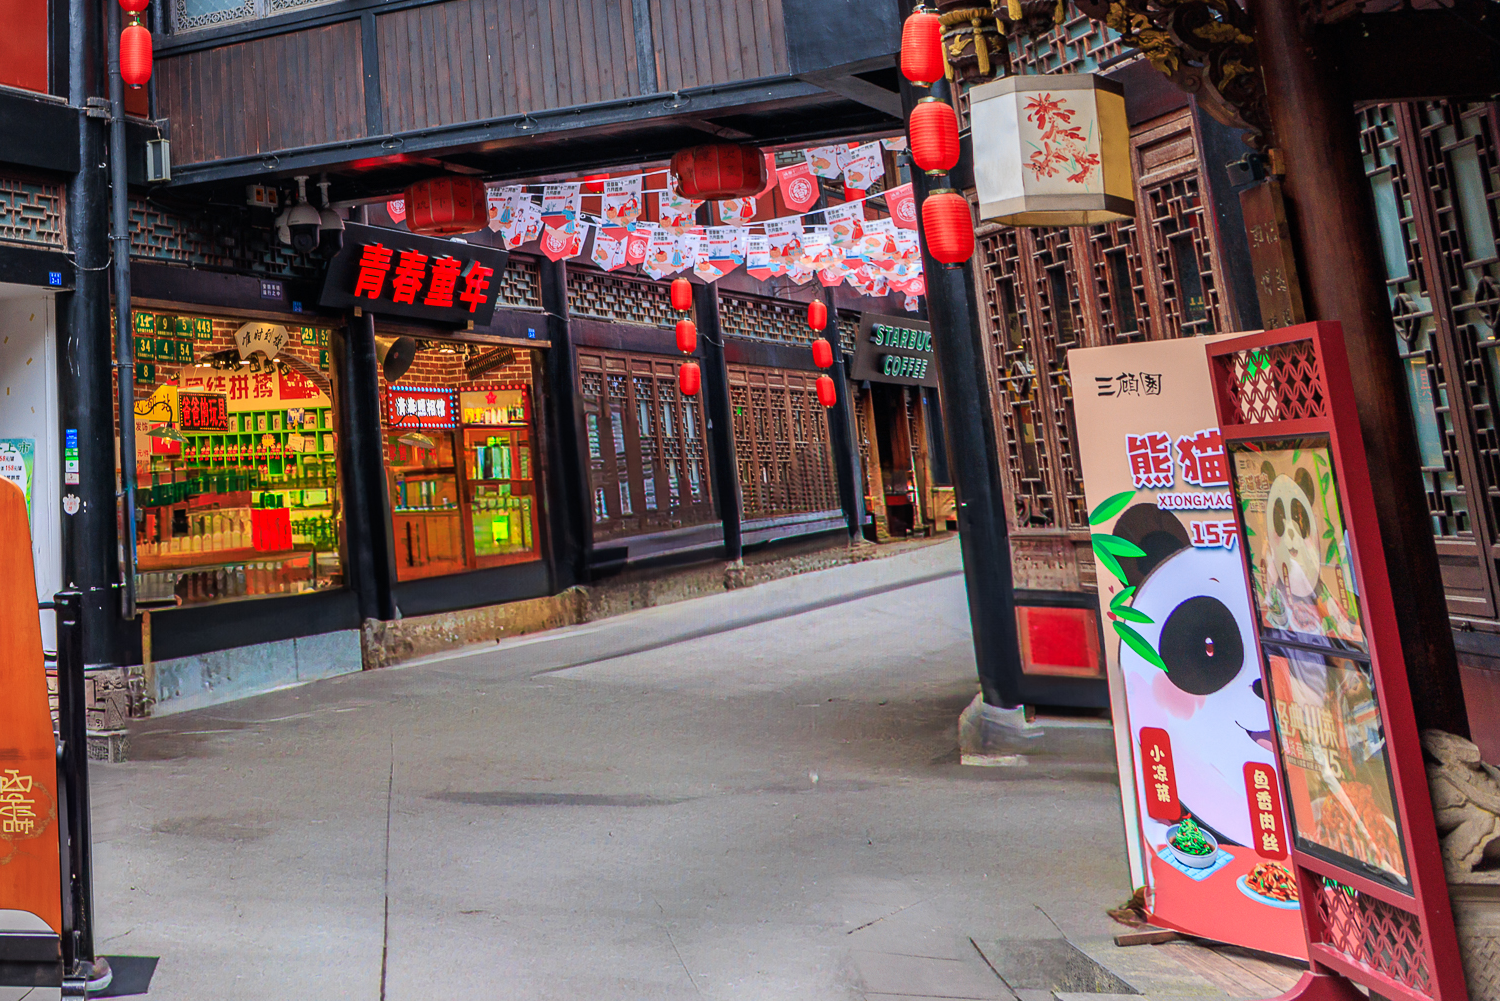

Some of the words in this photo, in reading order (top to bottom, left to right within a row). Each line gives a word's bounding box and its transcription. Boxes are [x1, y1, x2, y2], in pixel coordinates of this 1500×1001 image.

[354, 243, 494, 313] 青春童年
[183, 320, 187, 331] 5
[197, 321, 211, 333] 443
[875, 324, 934, 353] STARBUC
[140, 339, 151, 352] 34
[163, 342, 169, 354] 4
[180, 344, 190, 356] 54
[883, 355, 928, 379] COFFEE
[182, 396, 228, 428] 爸爸的玩具
[1127, 429, 1229, 488] 熊猫
[1149, 744, 1172, 803] 小凉菜
[1253, 769, 1280, 853] 鱼香肉丝
